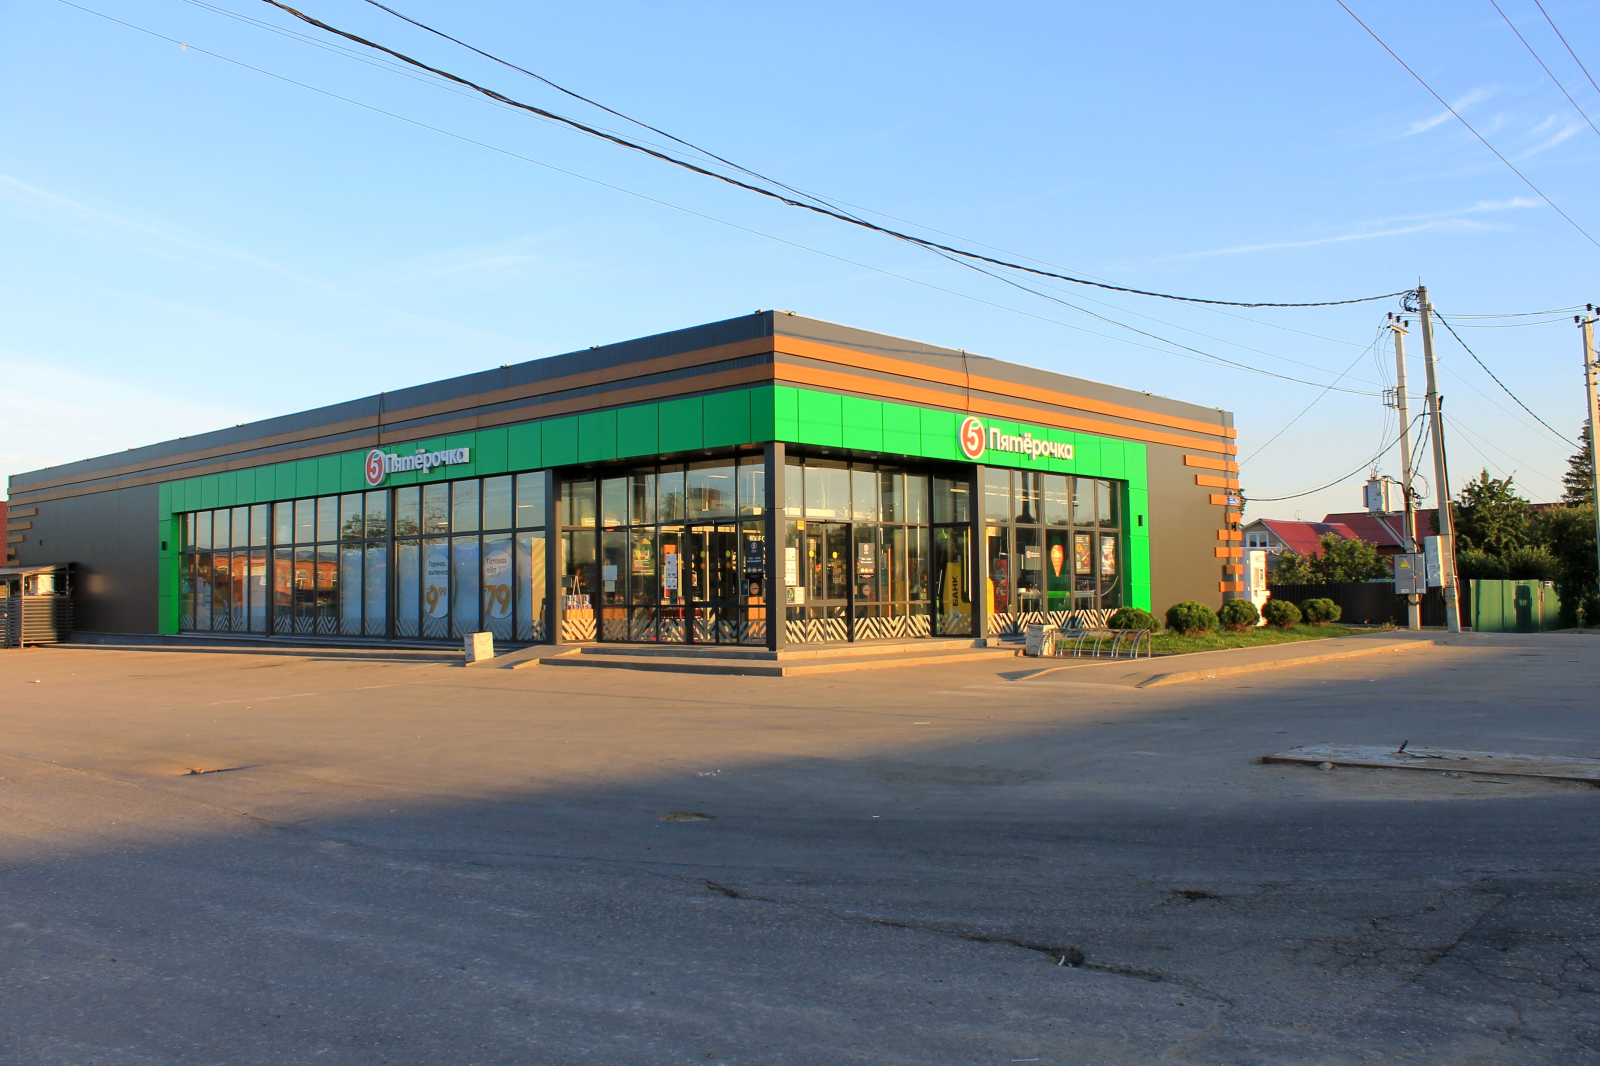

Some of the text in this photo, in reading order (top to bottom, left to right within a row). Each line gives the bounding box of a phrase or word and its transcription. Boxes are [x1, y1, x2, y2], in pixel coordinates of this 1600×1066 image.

[986, 427, 1074, 460] Пятёрочка
[385, 447, 470, 474] Пятёрочка
[484, 583, 511, 614] 79
